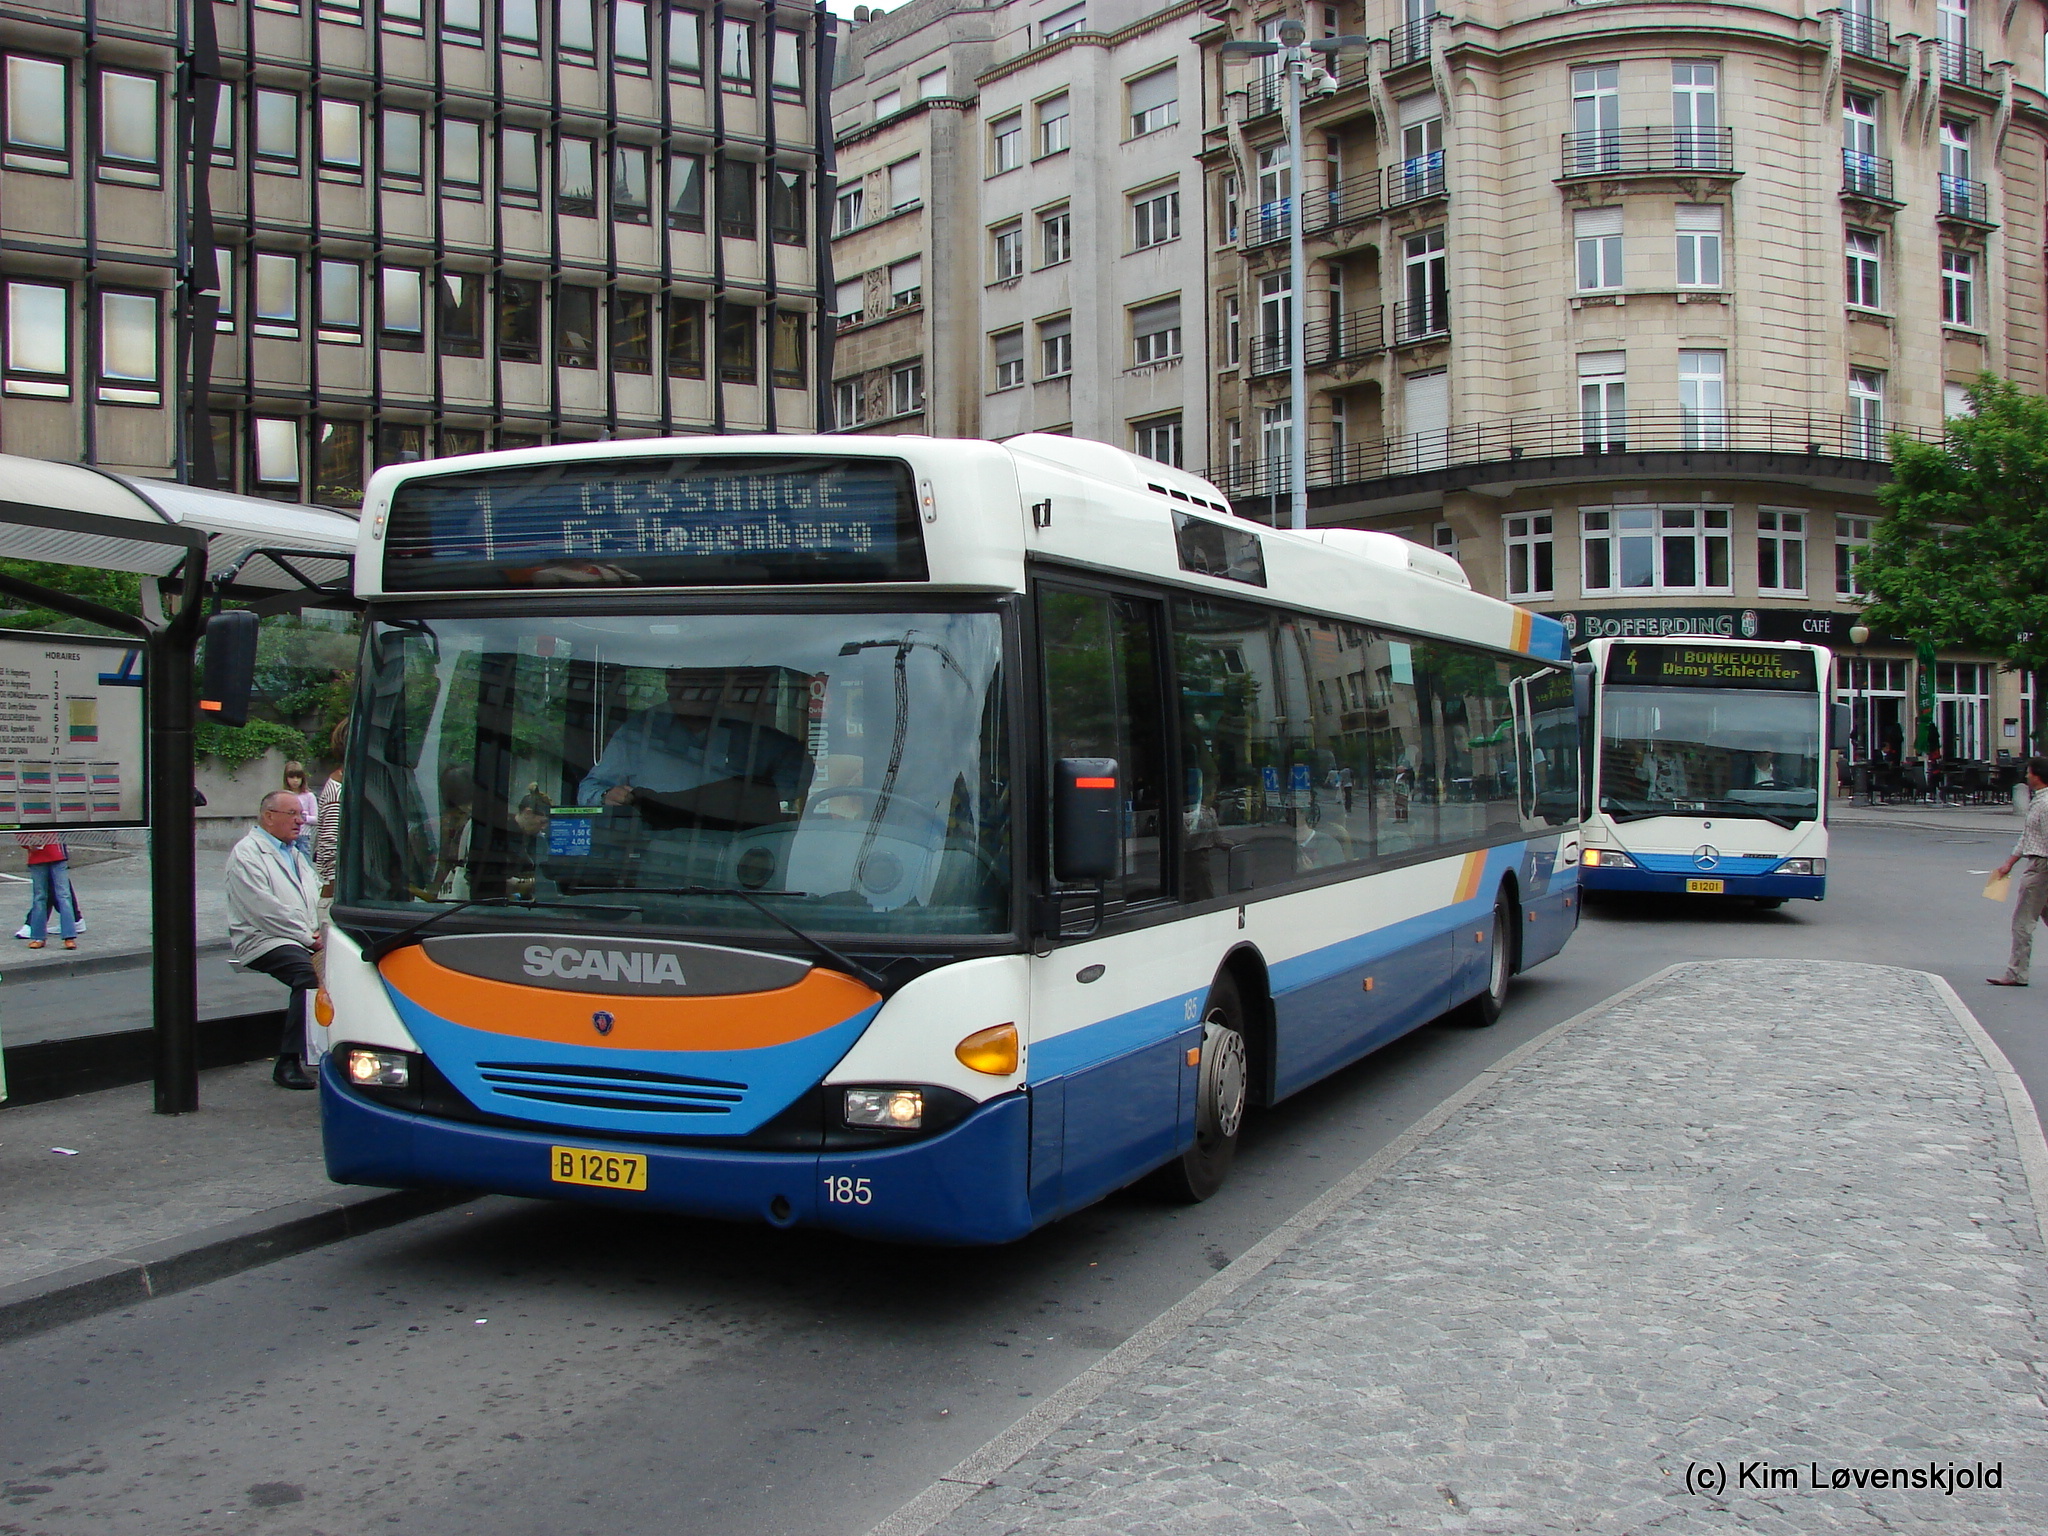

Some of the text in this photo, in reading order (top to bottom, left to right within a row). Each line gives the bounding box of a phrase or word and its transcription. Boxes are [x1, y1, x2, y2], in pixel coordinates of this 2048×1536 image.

[474, 473, 848, 561] 1 CESSANGE
[1585, 615, 1733, 637] BOFFERDING
[1802, 617, 1831, 634] CAFÉ
[45, 652, 81, 661] HORAIRES
[1626, 650, 1782, 674] 4 BONNEVOIE
[54, 670, 59, 678] 1
[1713, 664, 1801, 680] Schlechter
[54, 681, 59, 690] 2
[54, 692, 59, 701] 3
[54, 702, 59, 711] 4
[54, 713, 60, 722] 5
[54, 724, 60, 733] 6
[54, 735, 60, 744] 7
[50, 747, 60, 756] J1
[1699, 881, 1719, 892] 1201
[522, 945, 687, 986] SCANIA
[560, 1152, 638, 1184] B 1267
[823, 1175, 873, 1205] 185
